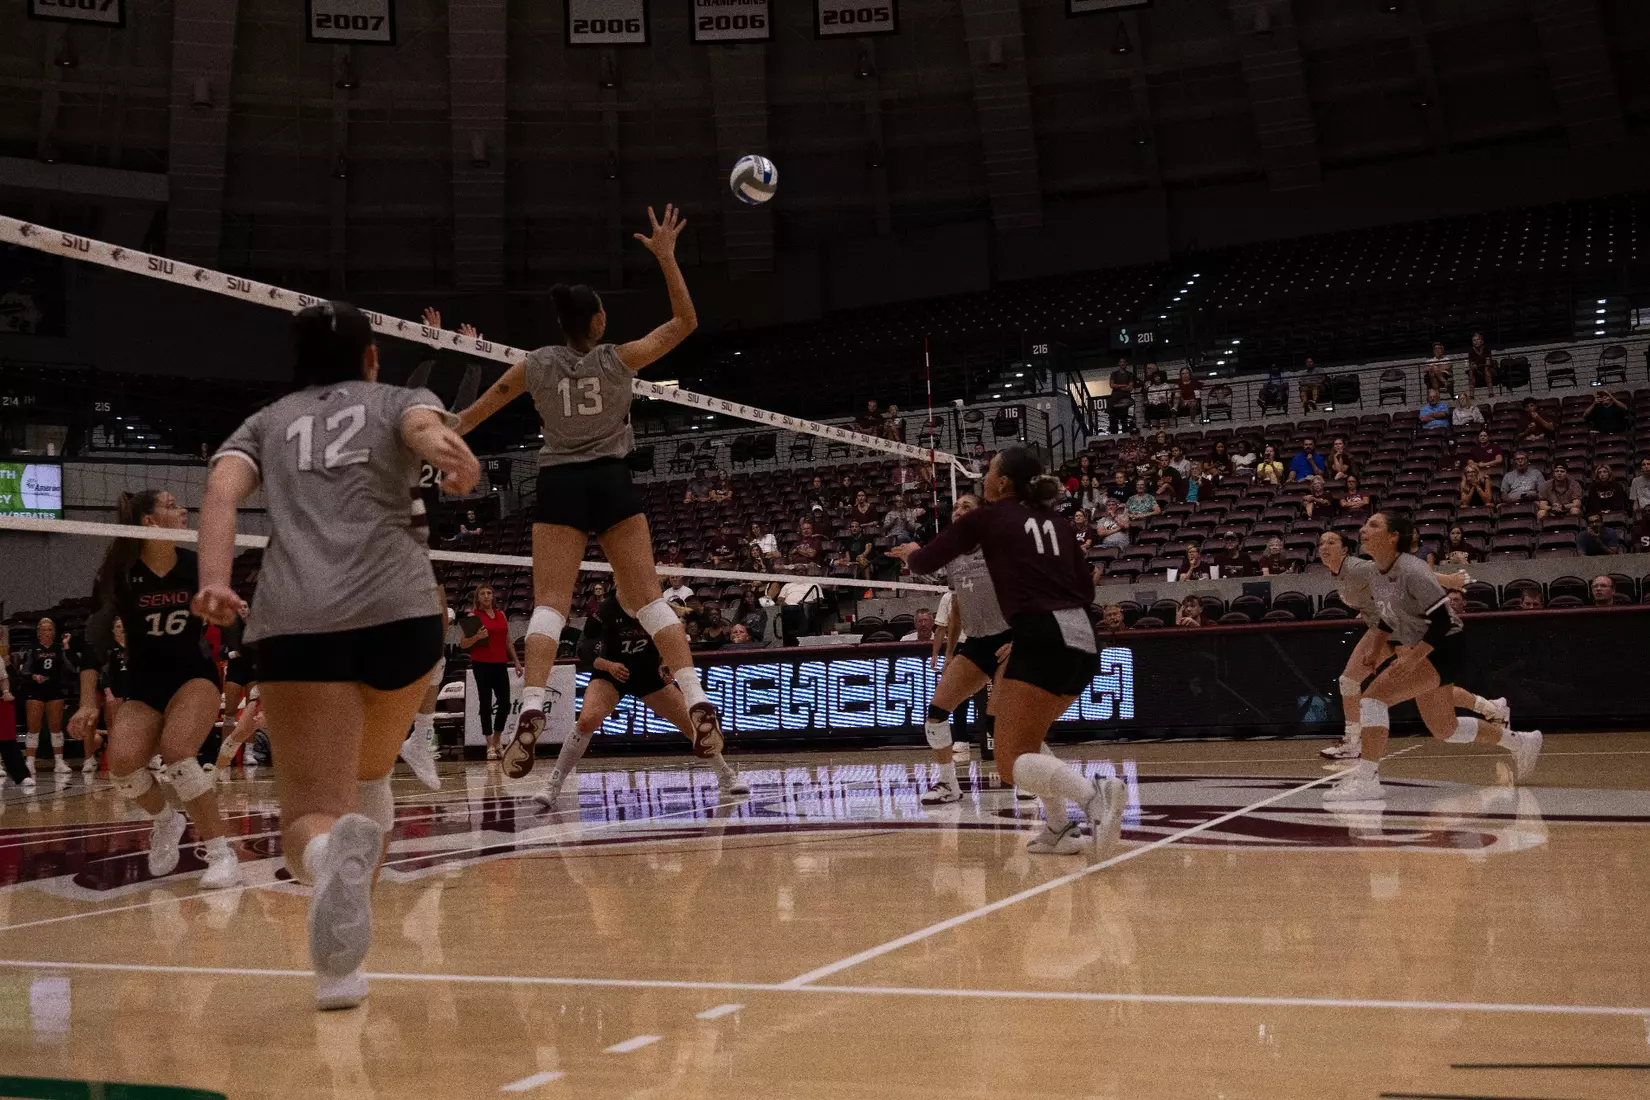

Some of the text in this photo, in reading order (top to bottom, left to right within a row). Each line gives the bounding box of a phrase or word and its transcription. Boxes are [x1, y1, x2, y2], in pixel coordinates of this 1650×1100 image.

[316, 13, 384, 31] 2007
[699, 15, 765, 30] 2006
[823, 7, 889, 25] 2005
[574, 19, 640, 33] 2006
[61, 233, 90, 252] SIU
[148, 256, 174, 275] SIU
[227, 277, 251, 293] SIU
[421, 326, 440, 341] SIU
[475, 340, 492, 354] SIU
[651, 384, 664, 395] SIU
[687, 392, 700, 404] SIU
[721, 401, 733, 412] SIU
[752, 409, 764, 419] SIU
[782, 416, 794, 426] SIU
[1137, 332, 1153, 344] 201
[1032, 344, 1048, 355] 216
[557, 377, 603, 417] 13
[1093, 399, 1108, 410] 101
[94, 401, 112, 412] 215
[1005, 407, 1018, 419] 116
[286, 404, 371, 472] 12
[488, 460, 499, 470] 115
[1023, 517, 1060, 556] 11
[137, 590, 189, 608] SEMO
[145, 609, 190, 637] 16
[620, 638, 648, 655] 12
[43, 658, 53, 670] 8
